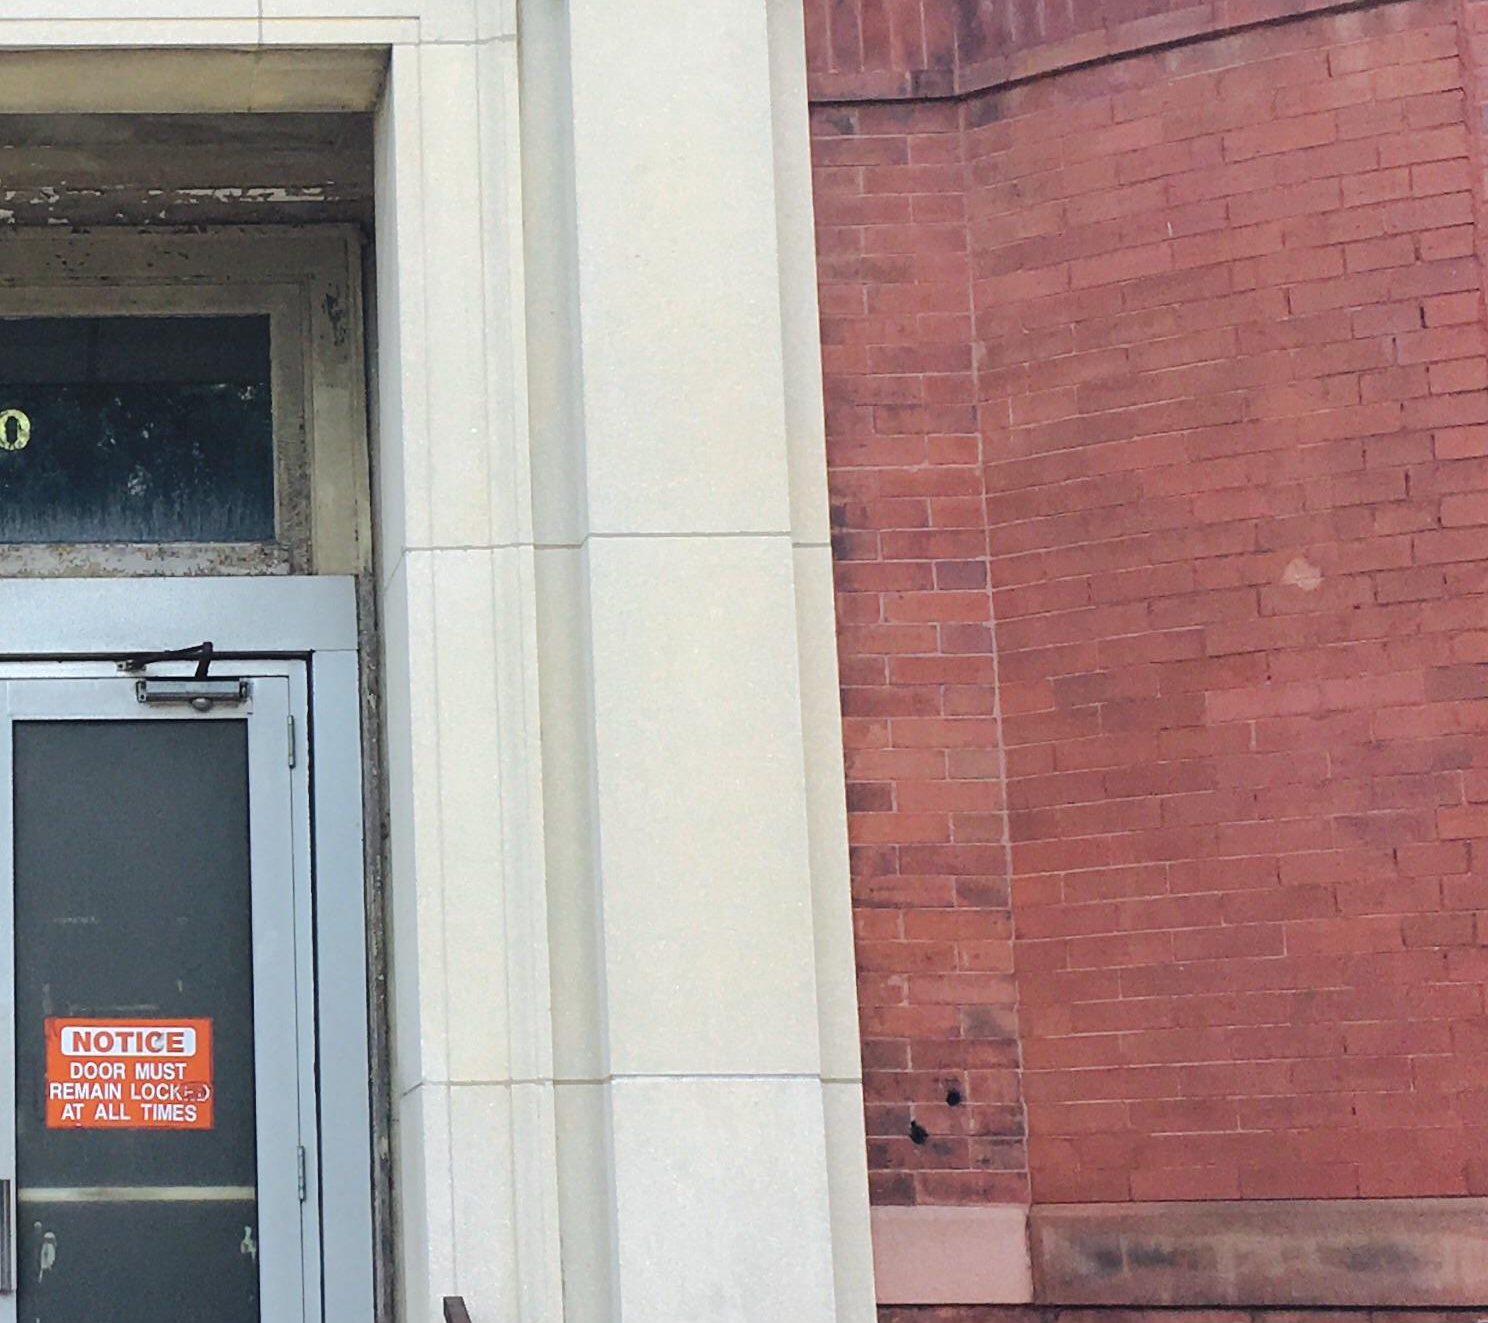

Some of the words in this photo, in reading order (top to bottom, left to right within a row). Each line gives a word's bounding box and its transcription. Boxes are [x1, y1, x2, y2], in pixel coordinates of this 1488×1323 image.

[72, 1031, 185, 1053] NOTICE
[70, 1062, 126, 1080] DOOR
[135, 1062, 187, 1080] MUST
[50, 1083, 122, 1100] REMAIN
[62, 1103, 85, 1120] AT
[94, 1104, 131, 1120] ALL
[140, 1104, 197, 1122] TIMES
